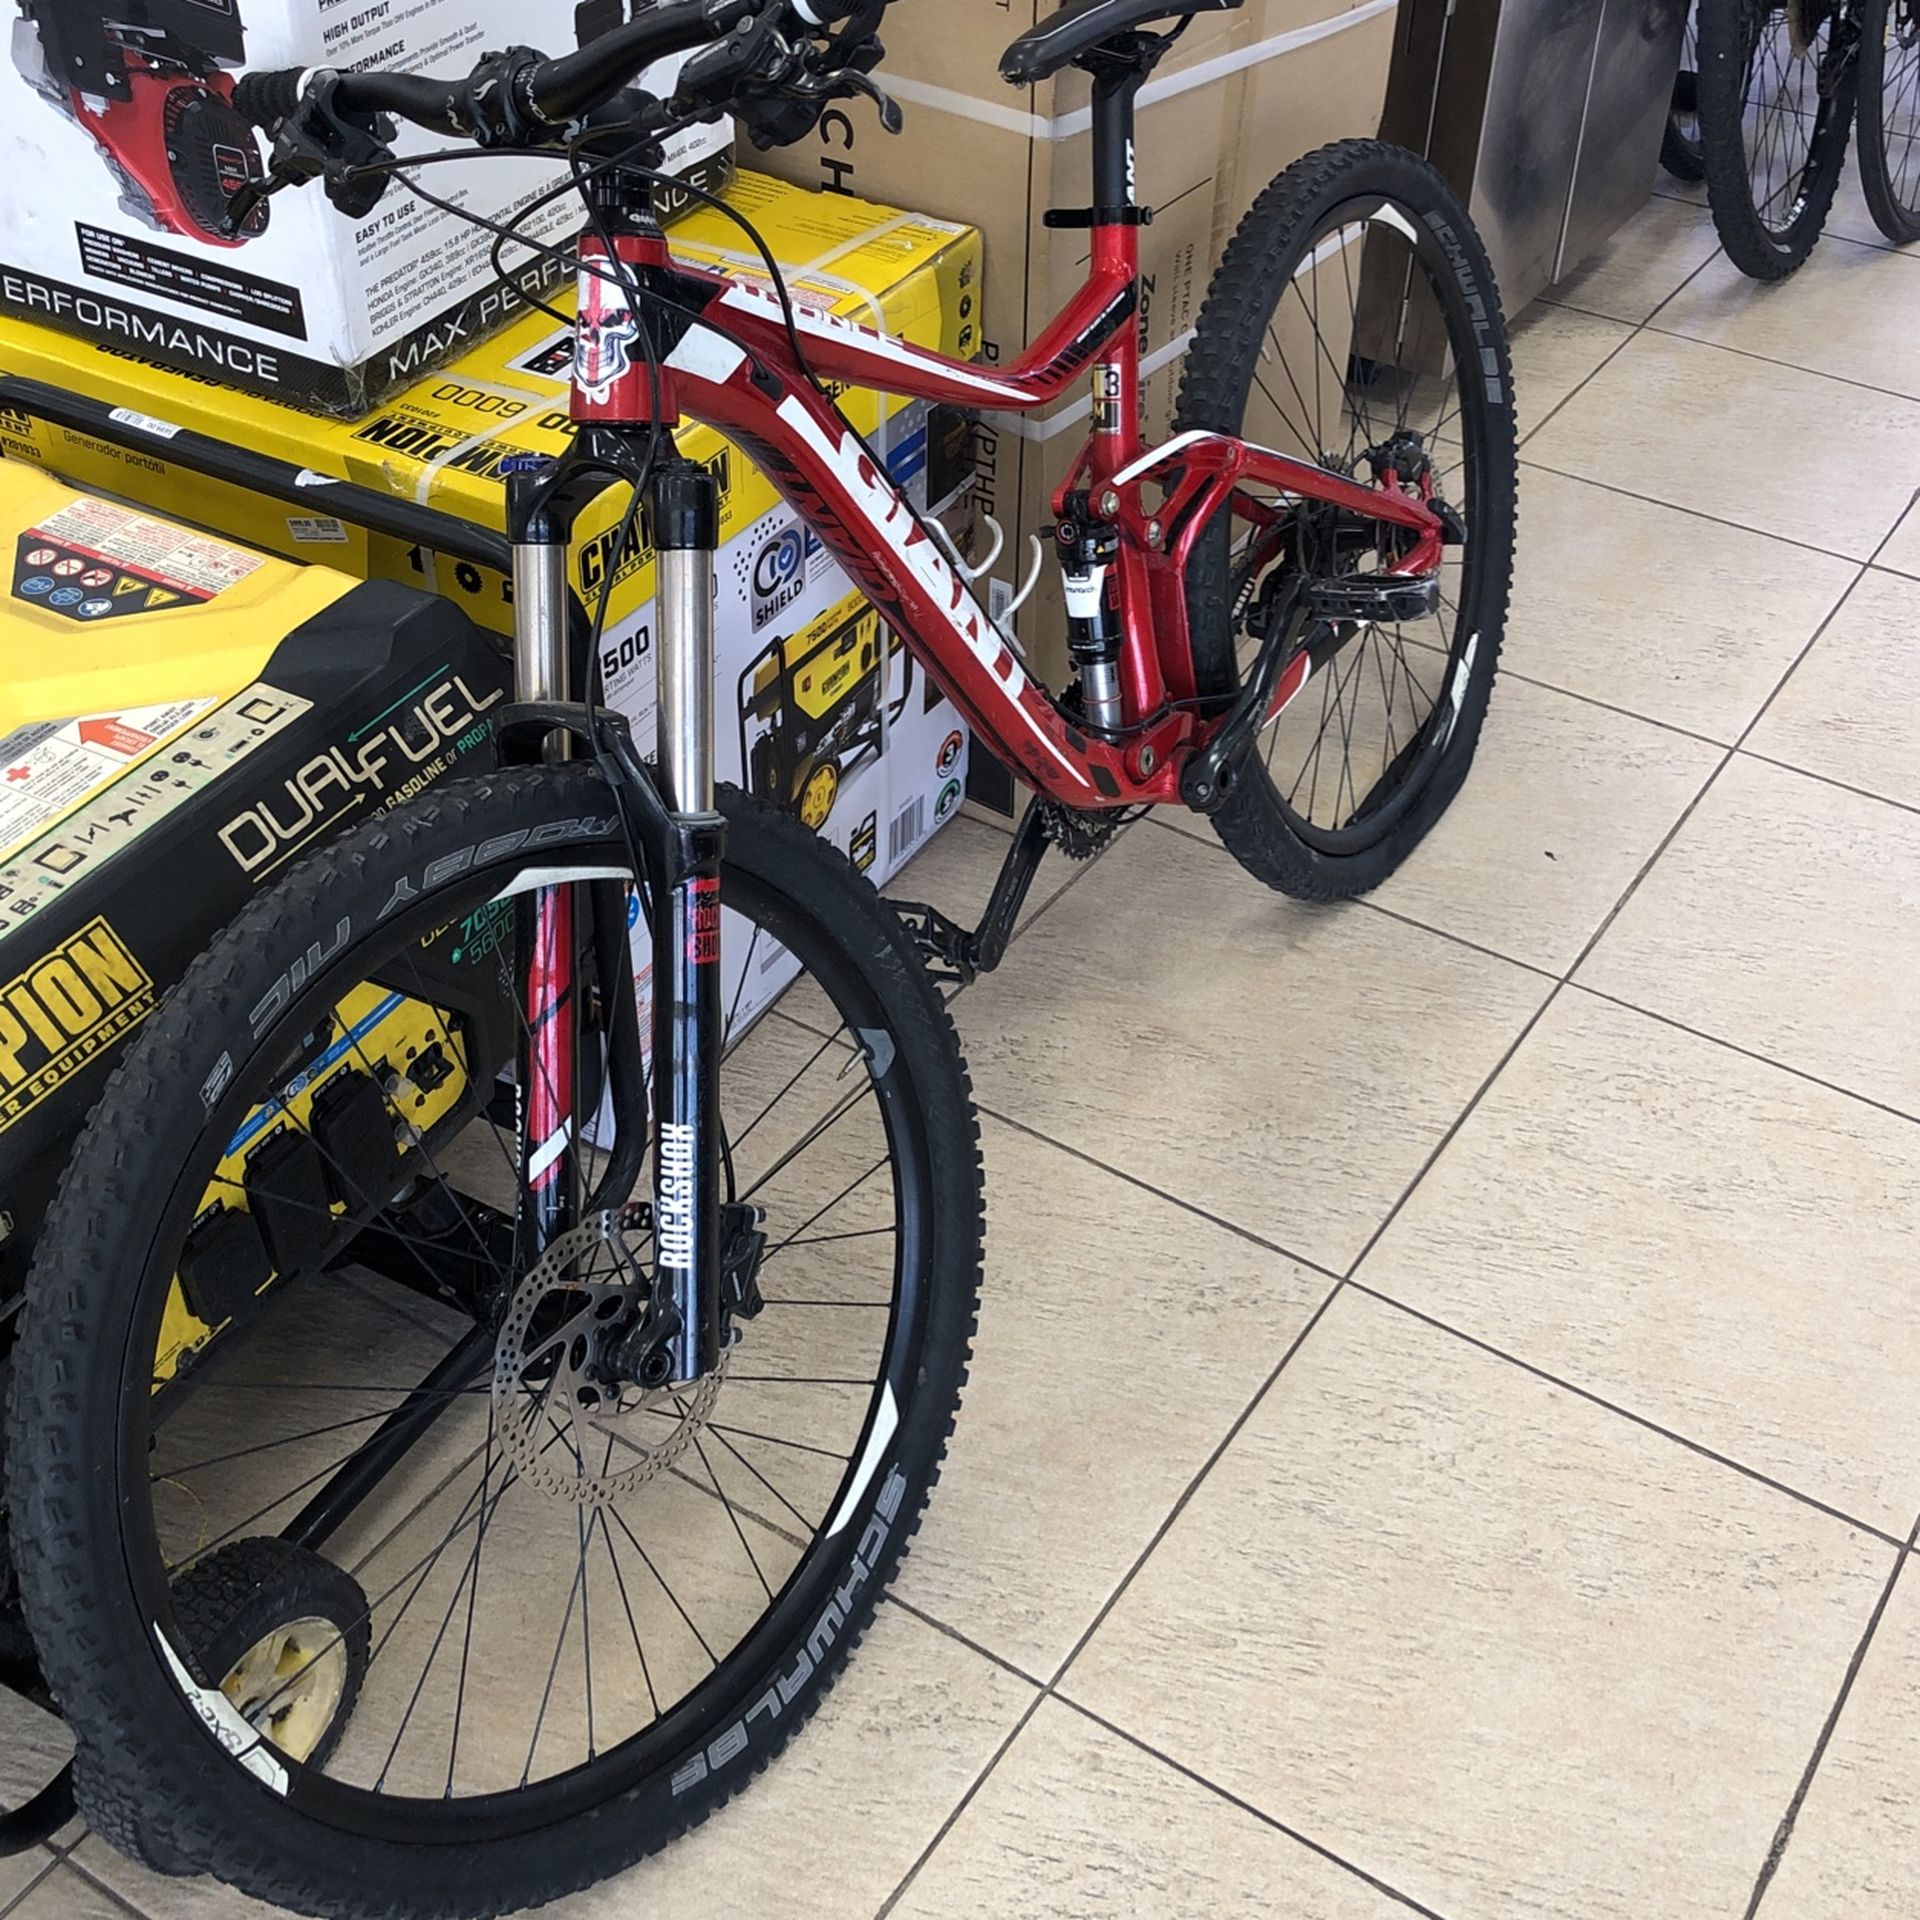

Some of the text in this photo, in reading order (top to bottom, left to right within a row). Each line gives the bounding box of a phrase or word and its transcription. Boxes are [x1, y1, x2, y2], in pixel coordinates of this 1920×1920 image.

[322, 21, 348, 43] HIGH
[350, 1, 390, 30] OUTPUT
[350, 39, 406, 75] FORMANCE
[95, 232, 110, 243] USE
[355, 199, 416, 244] EASY TO USE
[364, 282, 379, 298] THE
[460, 228, 470, 241] HP
[512, 189, 537, 211] ENGINE
[537, 185, 544, 196] IS
[551, 170, 572, 188] GREAT
[366, 289, 393, 311] HONDA
[369, 301, 396, 324] BRIGGS
[403, 275, 440, 303] STRATTON
[1422, 212, 1504, 404] SCHWALBE
[371, 315, 399, 337] KOHLER
[389, 301, 471, 380] MAX
[432, 383, 528, 419] 6000
[63, 430, 122, 460] Generador
[756, 578, 804, 628] SHIELD
[627, 653, 652, 682] WATTS
[385, 756, 447, 811] GASOLINE
[446, 747, 458, 765] or
[249, 917, 351, 1041] NIC
[29, 990, 156, 1096] EQUIPMENT
[659, 1122, 695, 1269] ROCKSHOX
[671, 1462, 908, 1797] SCHWALBE
